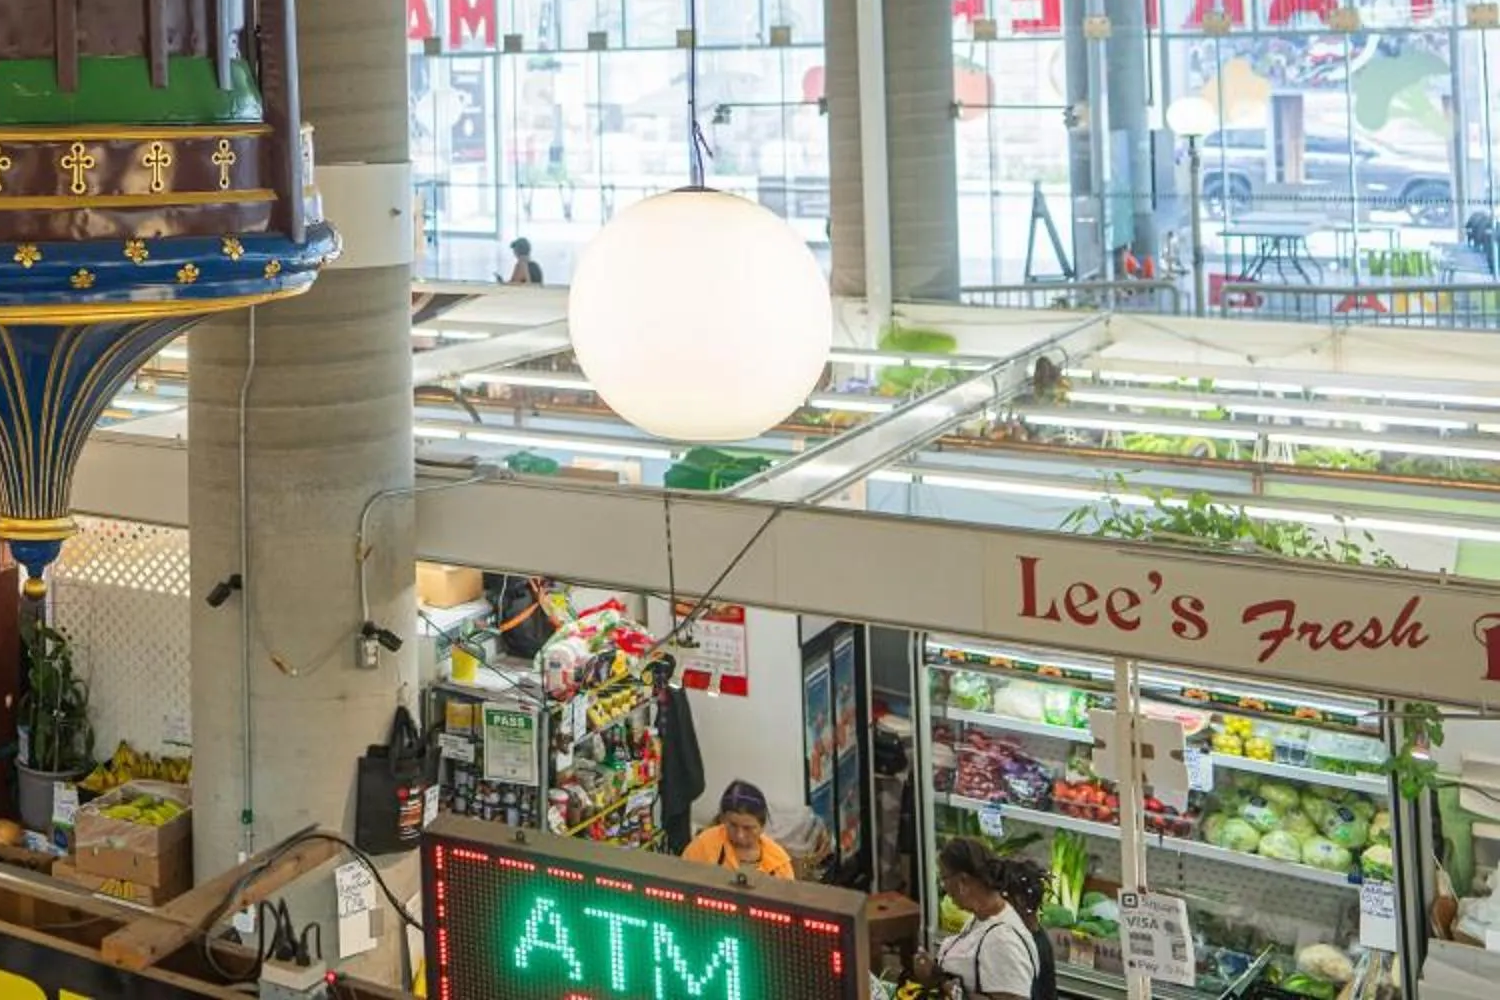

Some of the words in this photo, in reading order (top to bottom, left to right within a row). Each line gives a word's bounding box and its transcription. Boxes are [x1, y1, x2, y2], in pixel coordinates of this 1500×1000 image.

[1015, 554, 1210, 641] Lee's
[1241, 595, 1430, 664] Fresh
[493, 714, 525, 728] PASS
[513, 896, 743, 1000] ATM
[1126, 915, 1159, 930] VISA
